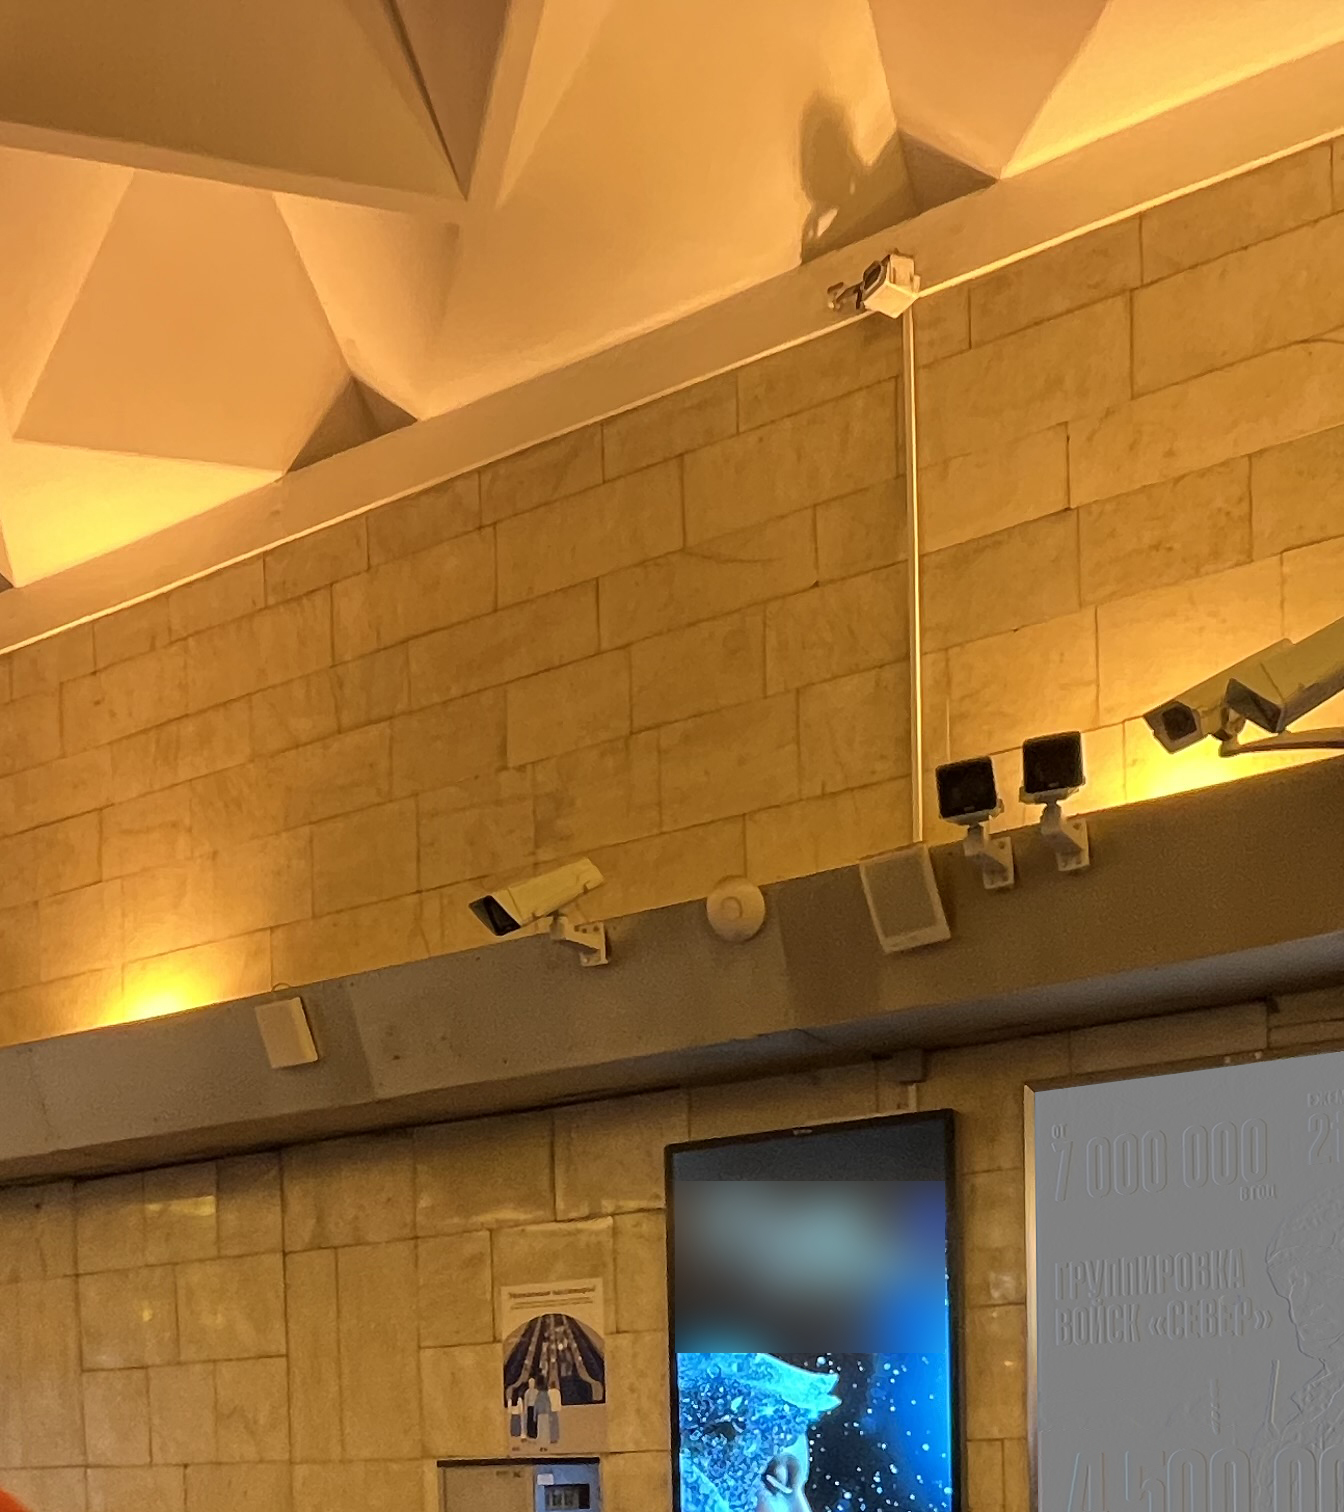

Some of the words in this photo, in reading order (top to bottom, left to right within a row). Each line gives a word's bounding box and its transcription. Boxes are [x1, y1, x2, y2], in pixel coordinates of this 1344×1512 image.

[1051, 1123, 1068, 1140] ОТ
[1051, 1140, 1074, 1202] 7
[1086, 1128, 1168, 1199] 000
[1181, 1117, 1268, 1189] 000
[1239, 1186, 1249, 1202] В
[1250, 1183, 1277, 1201] ГОД
[1055, 1248, 1246, 1300] ГРУППИРОВКА
[1055, 1298, 1142, 1346] ВОЙСК
[1148, 1297, 1273, 1341] «СЕВЕР»
